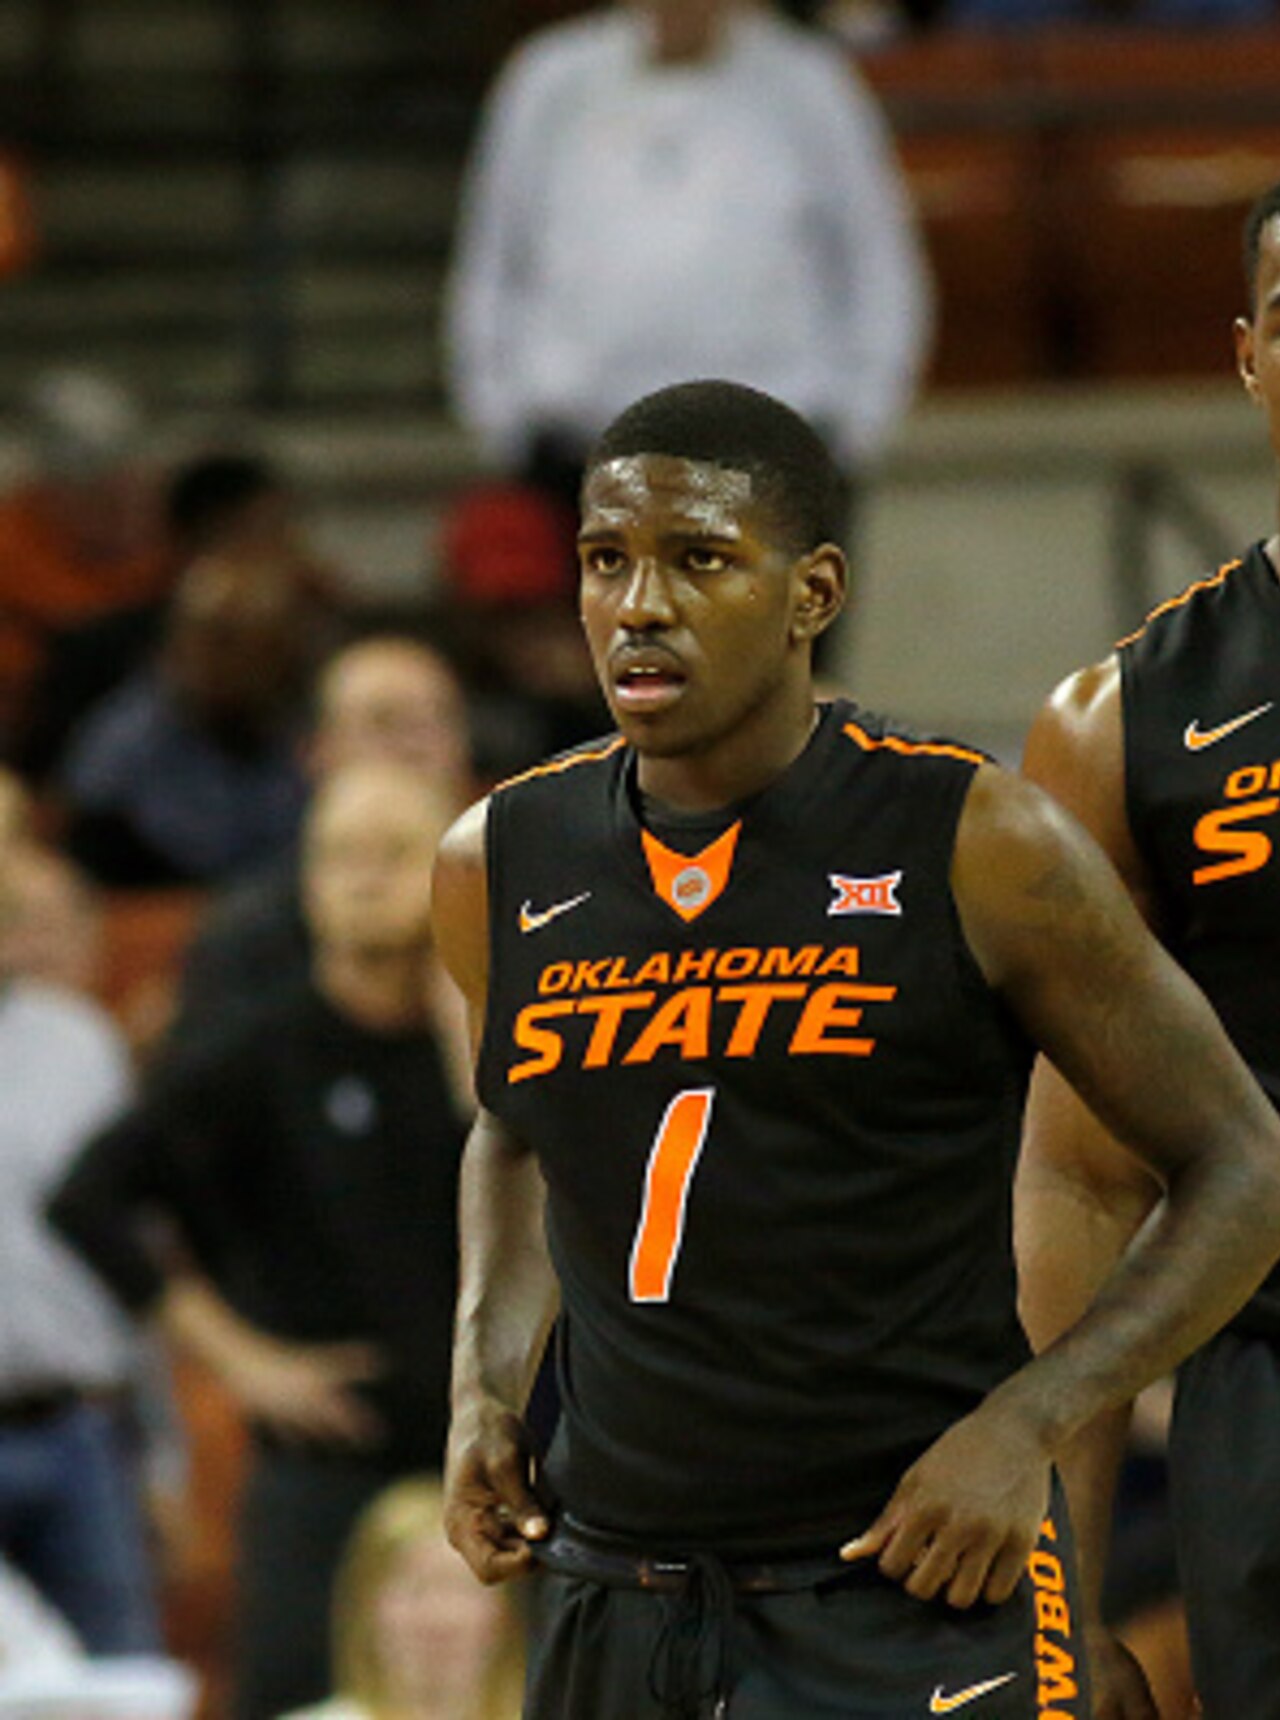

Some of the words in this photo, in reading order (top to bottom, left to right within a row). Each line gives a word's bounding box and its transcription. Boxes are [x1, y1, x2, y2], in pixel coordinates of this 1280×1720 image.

[507, 982, 898, 1084] STATE
[537, 946, 860, 995] OKLAHOMA
[628, 1087, 716, 1304] 1
[1028, 1517, 1078, 1720] WBO
